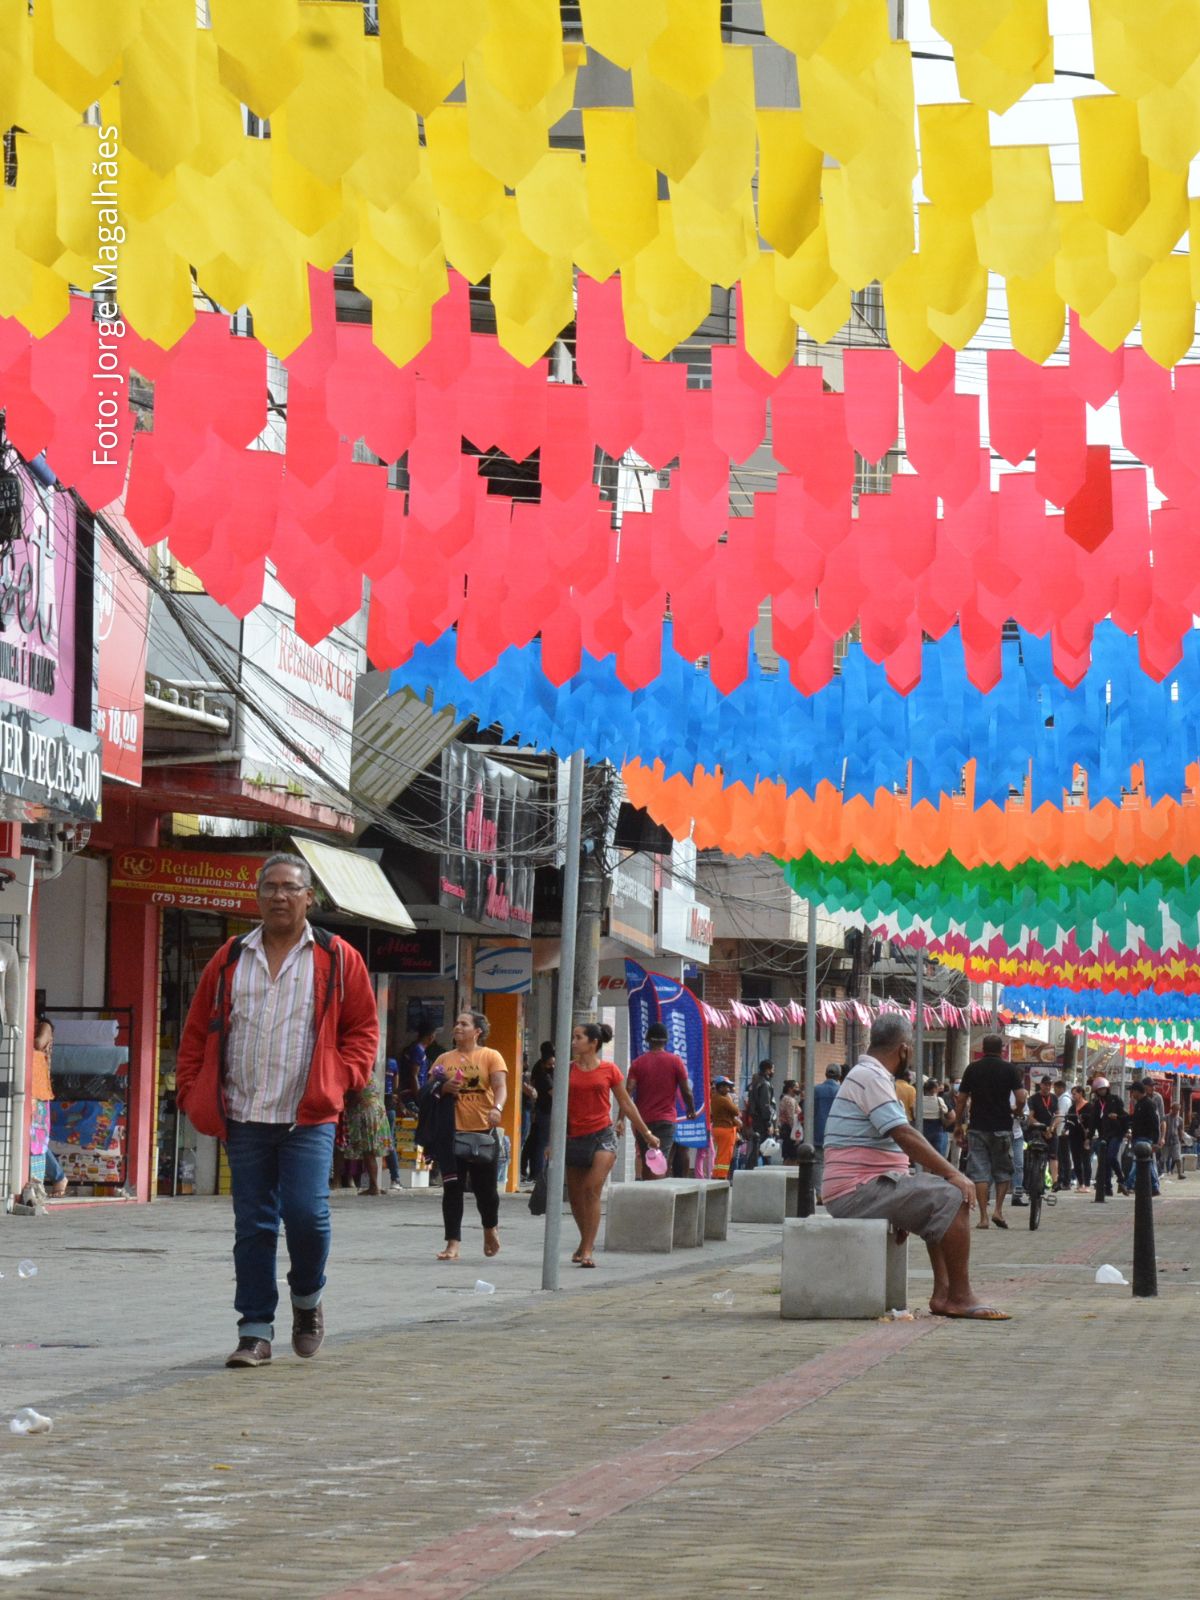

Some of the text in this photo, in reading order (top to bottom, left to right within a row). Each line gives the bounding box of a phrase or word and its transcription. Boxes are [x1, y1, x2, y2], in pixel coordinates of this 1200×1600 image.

[108, 706, 138, 750] 18,00
[0, 719, 25, 779] ER
[160, 858, 250, 881] Retalhos &
[175, 875, 182, 884] O
[183, 876, 223, 888] MELHOR
[223, 878, 246, 889] ESTÁ
[151, 891, 176, 904] (75)
[179, 894, 242, 909] 3221-0591
